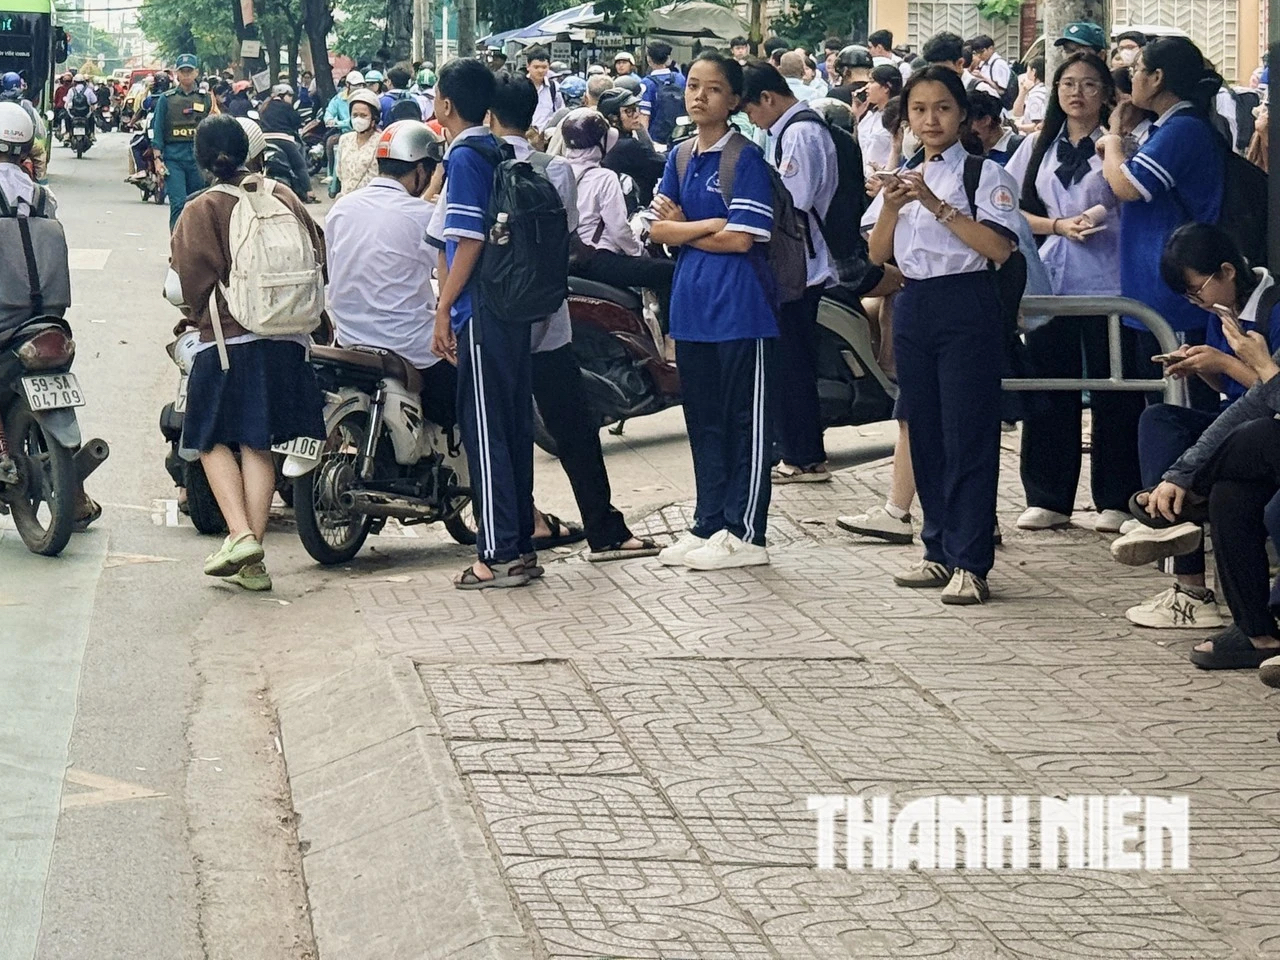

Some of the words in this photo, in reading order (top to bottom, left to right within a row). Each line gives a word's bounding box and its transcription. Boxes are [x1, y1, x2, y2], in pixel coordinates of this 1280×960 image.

[173, 129, 196, 137] DQT
[31, 375, 71, 392] 59-SA
[32, 390, 81, 408] 047.09
[274, 438, 318, 456] 1.06
